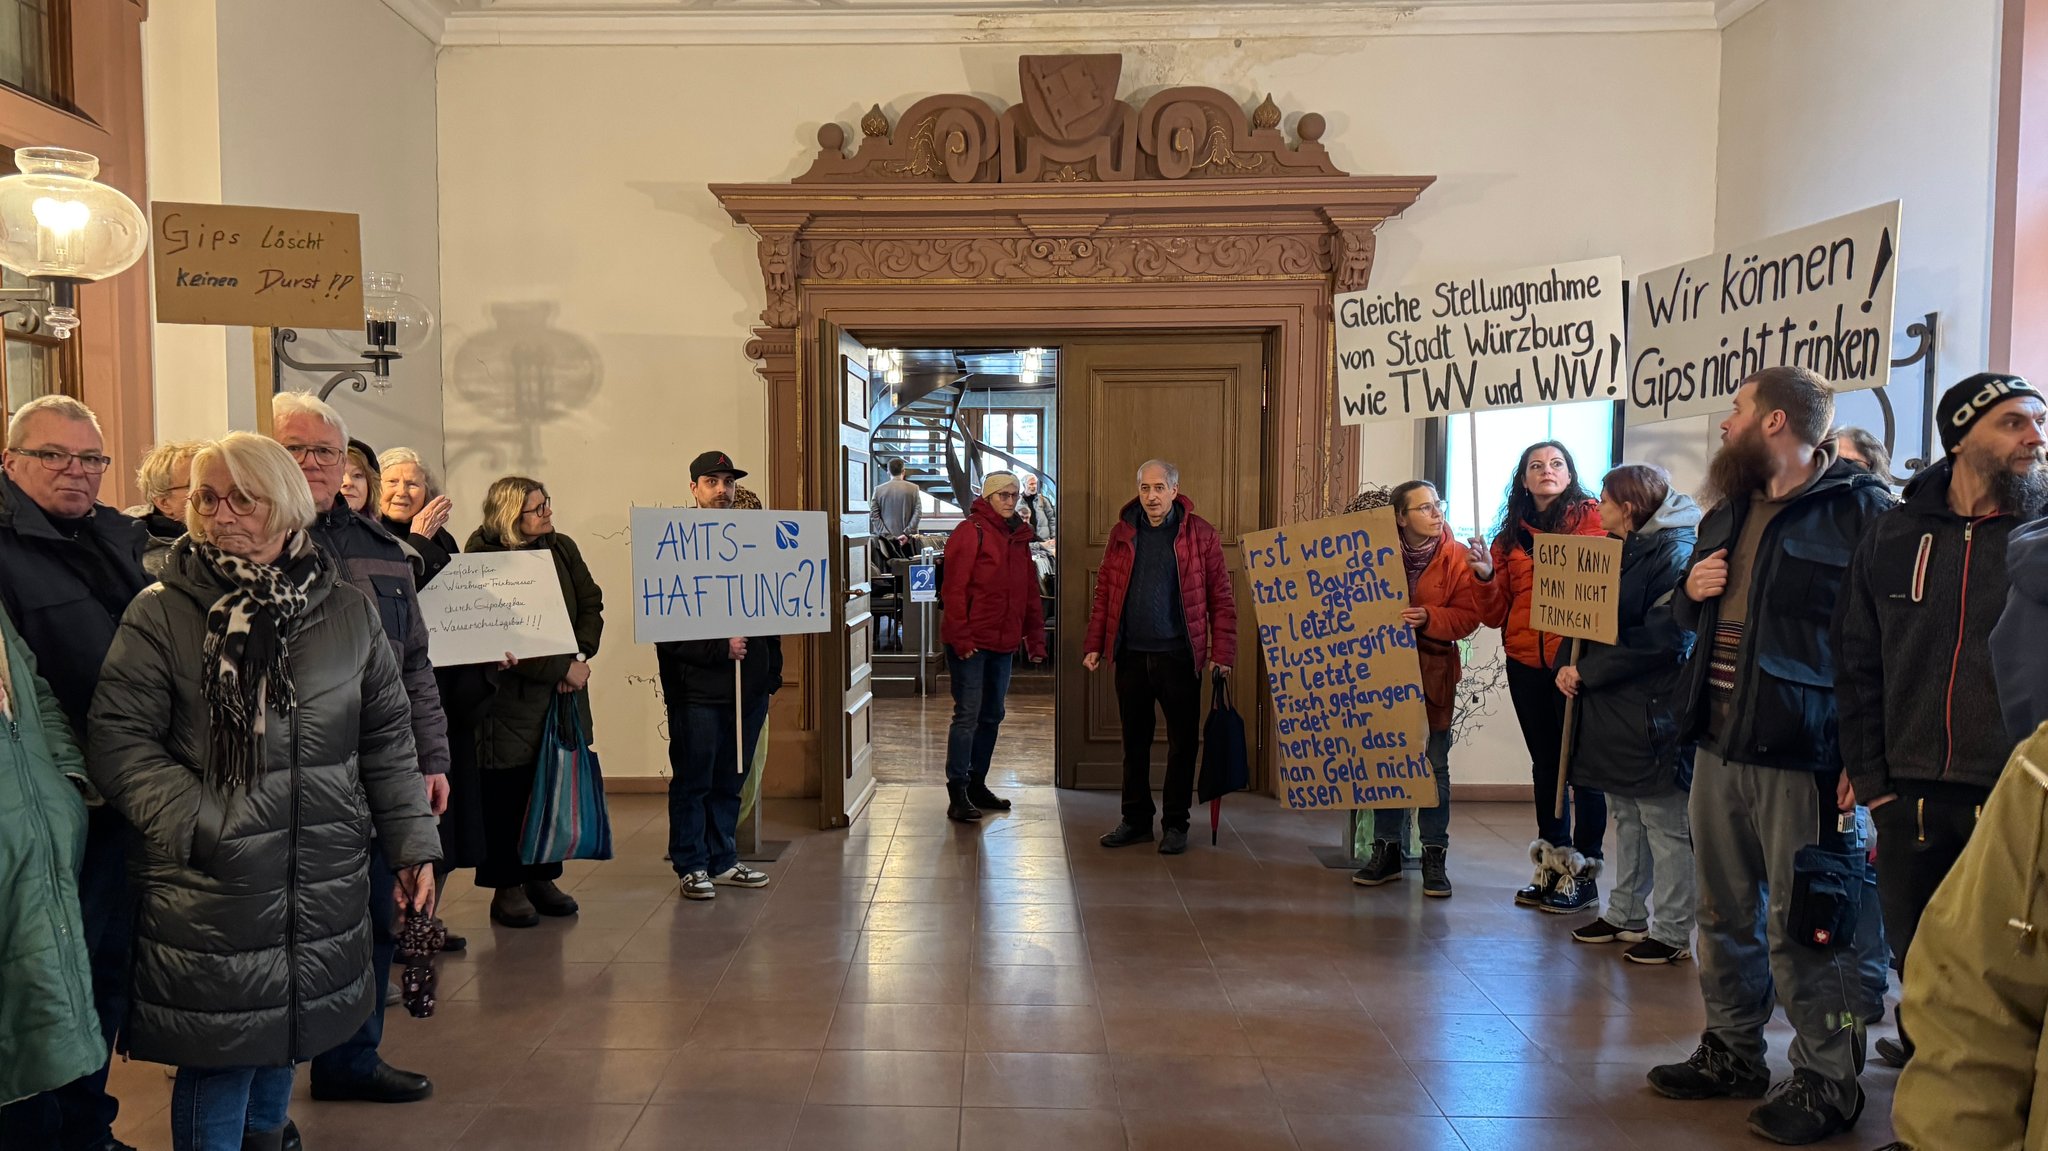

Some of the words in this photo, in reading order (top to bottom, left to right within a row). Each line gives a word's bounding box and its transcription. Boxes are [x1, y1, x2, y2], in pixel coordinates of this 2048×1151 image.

[163, 213, 240, 255] Gips
[261, 225, 324, 250] Löscht
[1340, 291, 1421, 328] Gleiche
[1432, 268, 1601, 322] Stellungnahme
[1644, 267, 1710, 328] Wir
[1721, 237, 1854, 314] können
[1340, 347, 1375, 370] von
[1386, 324, 1455, 367] Stadt
[1464, 313, 1594, 357] Würzburg
[1631, 347, 1696, 419] Gips
[1700, 322, 1773, 399] nicht
[1779, 303, 1879, 381] trinken
[1344, 383, 1387, 417] wie
[1389, 360, 1477, 413] TWV
[1485, 368, 1523, 406] und
[656, 521, 756, 562] AMTS-
[1249, 531, 1290, 569] rst
[1300, 529, 1370, 562] wenn
[1346, 546, 1395, 569] der
[1539, 544, 1567, 567] GIPS
[1577, 547, 1611, 574] KANN
[643, 558, 827, 618] HAFTUNG?!
[1252, 577, 1298, 604] tzte
[1306, 567, 1377, 598] Baum
[1321, 578, 1403, 613] gefällt,
[1540, 577, 1565, 599] MAN
[1575, 583, 1607, 603] NICHT
[1259, 624, 1282, 646] er
[1288, 610, 1355, 641] letzte
[1267, 646, 1325, 668] Fluss
[1268, 671, 1293, 694] er
[1300, 659, 1371, 691] letzte
[1274, 691, 1325, 714] Fisch
[1329, 683, 1425, 717] gefangen,
[1278, 710, 1330, 735] erdet
[1342, 709, 1373, 729] ihr
[1361, 729, 1408, 750] dass
[1323, 757, 1369, 784] Geld
[1377, 753, 1431, 779] nicht
[1288, 784, 1343, 809] essen
[1352, 782, 1412, 804] kann.
